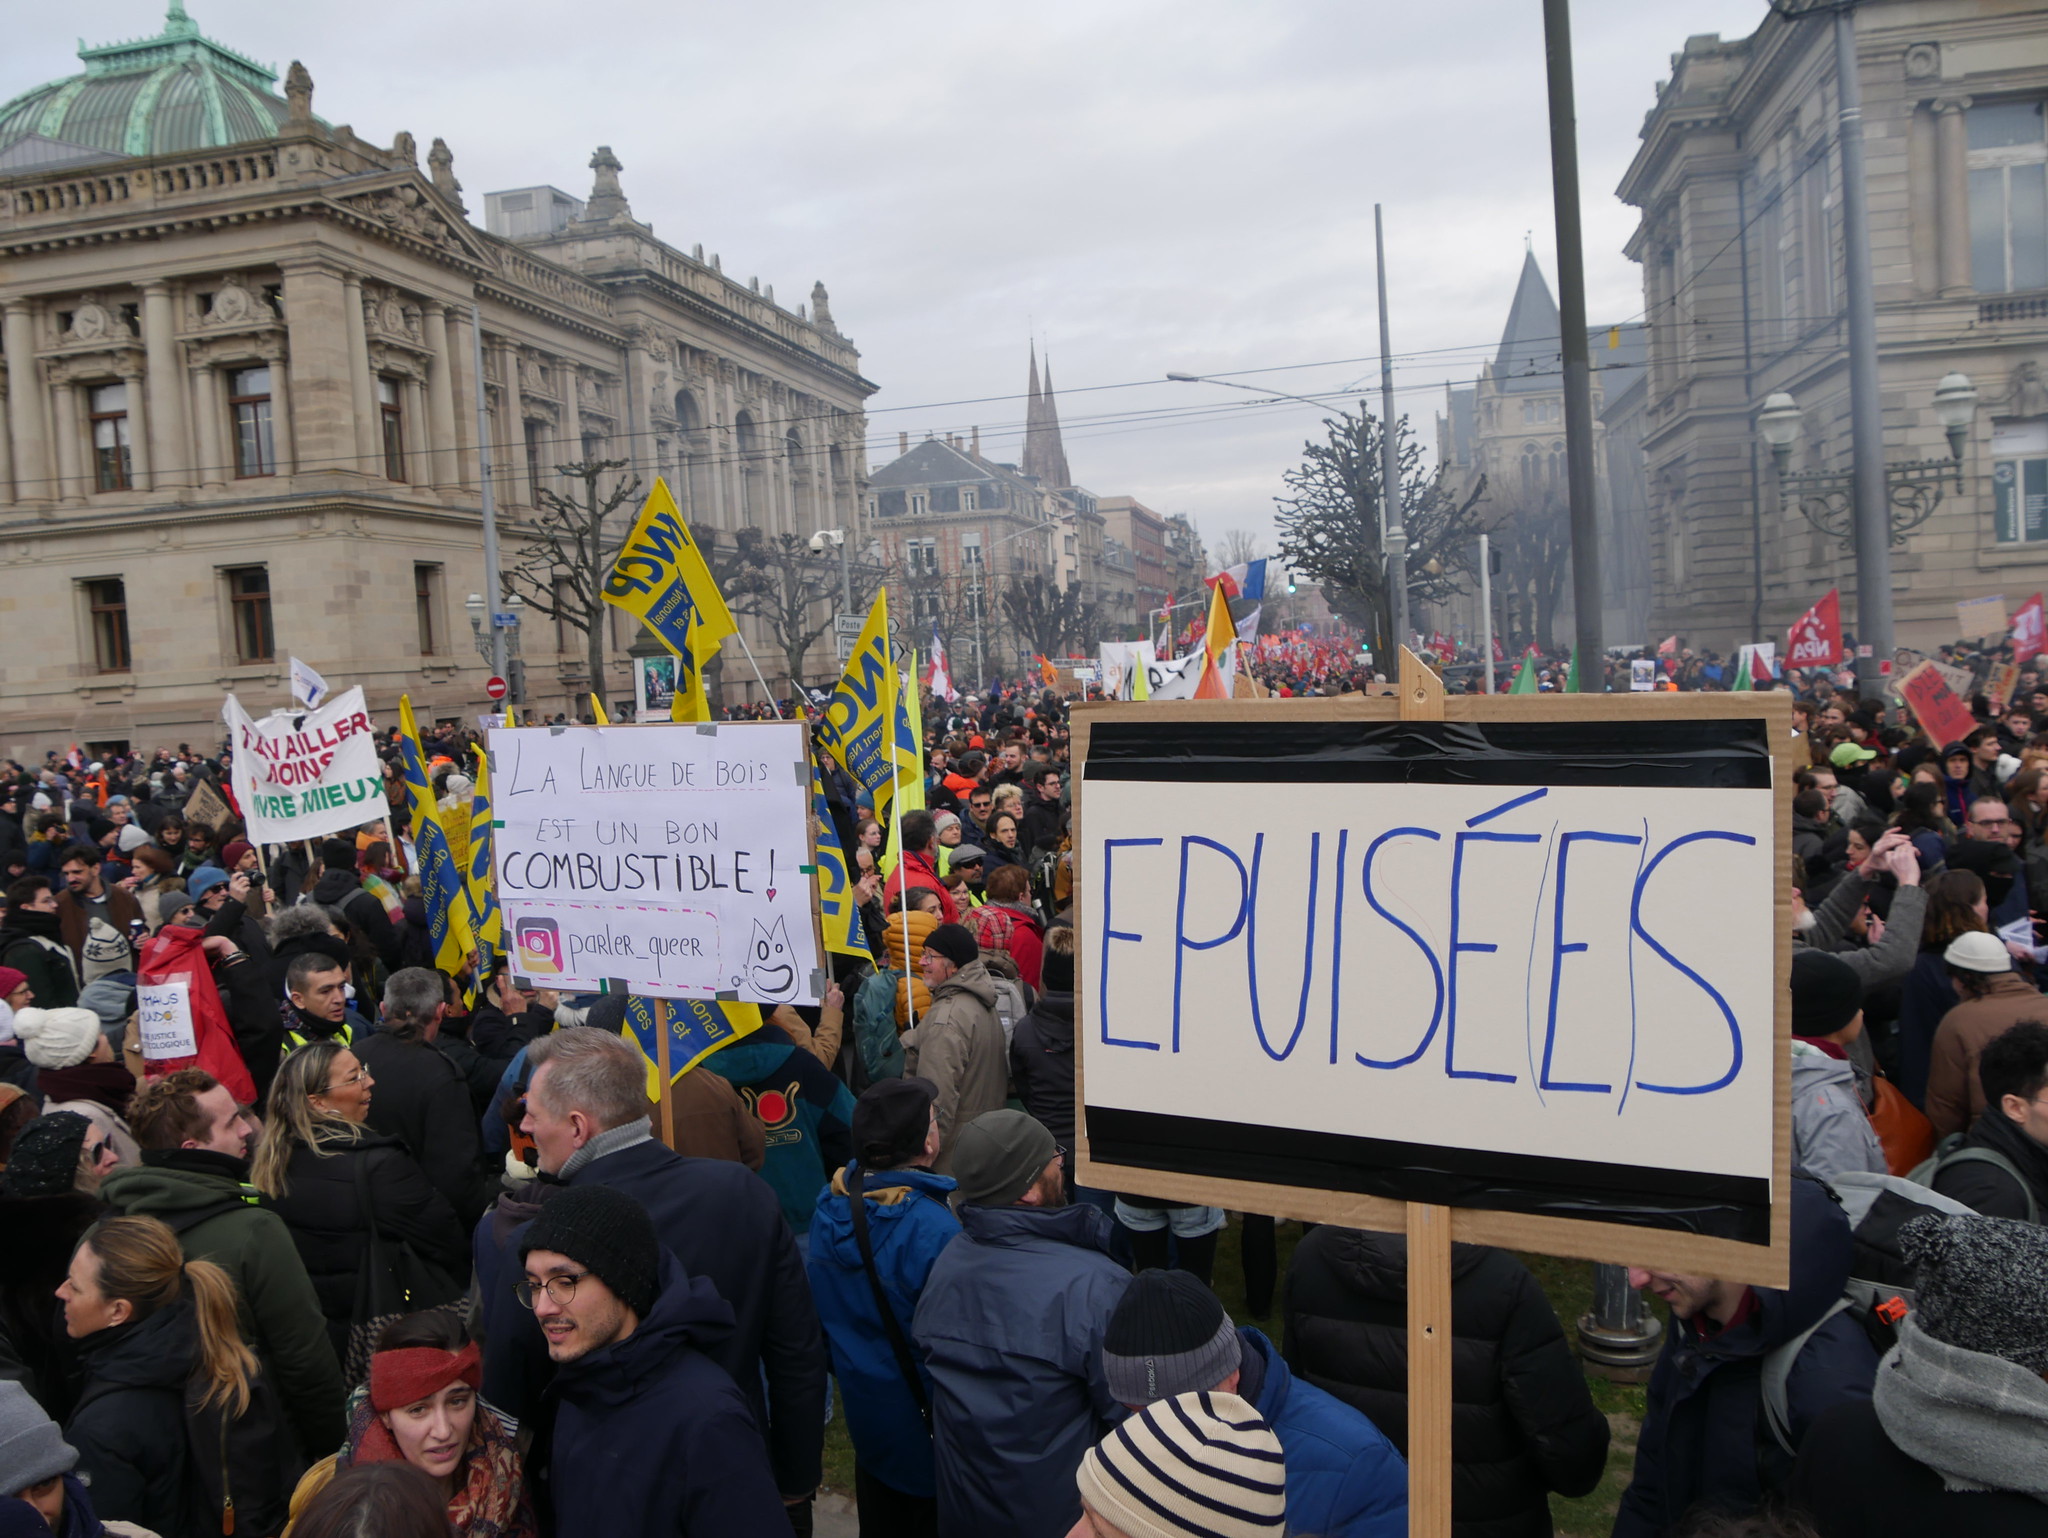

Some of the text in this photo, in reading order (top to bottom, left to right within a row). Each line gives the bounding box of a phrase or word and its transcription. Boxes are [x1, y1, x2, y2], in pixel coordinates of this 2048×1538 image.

[242, 712, 371, 761] TAVAILLER
[509, 738, 557, 796] LA
[581, 747, 657, 790] LANGUE
[672, 761, 695, 786] DE
[302, 776, 385, 814] MIEUX
[536, 818, 719, 845] EST UN BON
[672, 1021, 692, 1041] et
